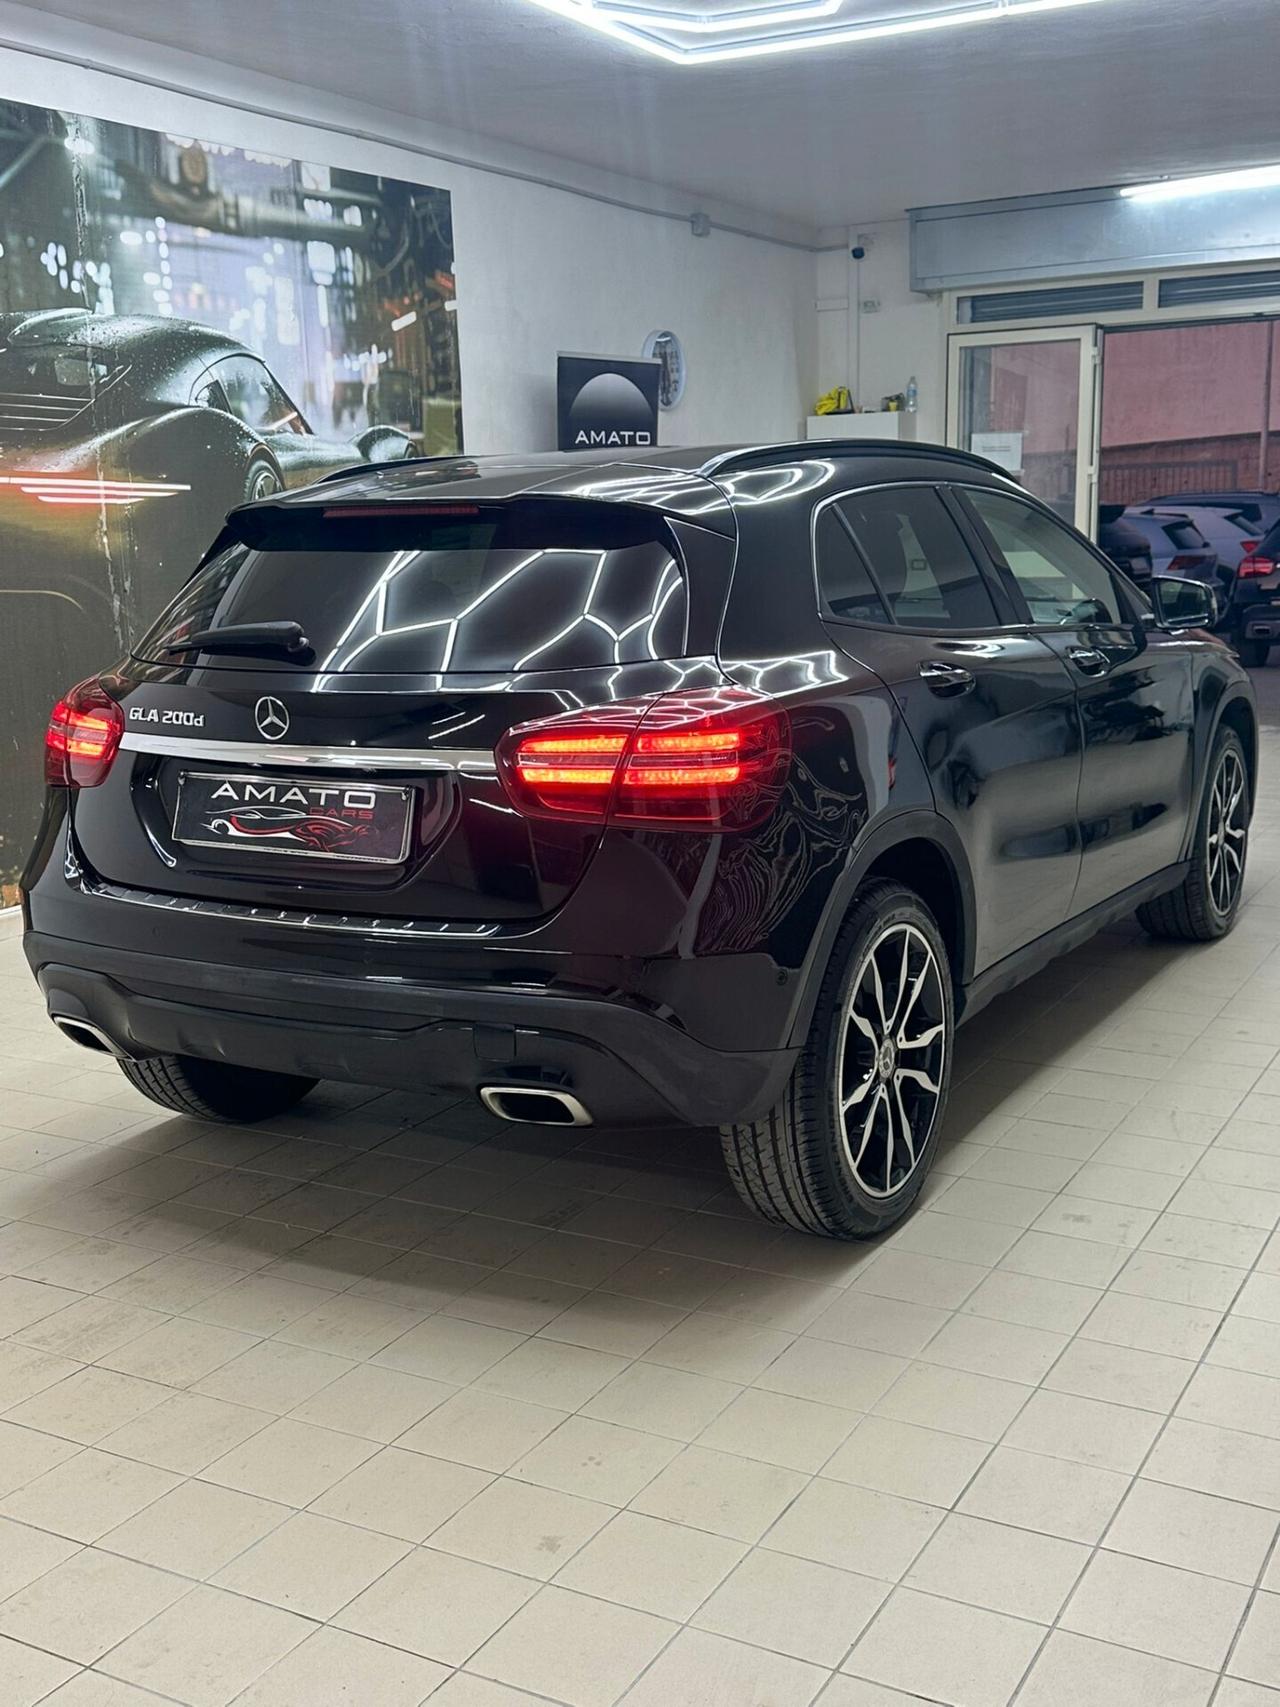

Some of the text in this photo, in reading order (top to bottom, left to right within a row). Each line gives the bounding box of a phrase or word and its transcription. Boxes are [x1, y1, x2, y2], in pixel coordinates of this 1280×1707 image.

[575, 430, 651, 445] AMATO
[129, 707, 205, 727] GLA 200d
[210, 781, 376, 809] AMATO
[309, 806, 374, 820] CARS
